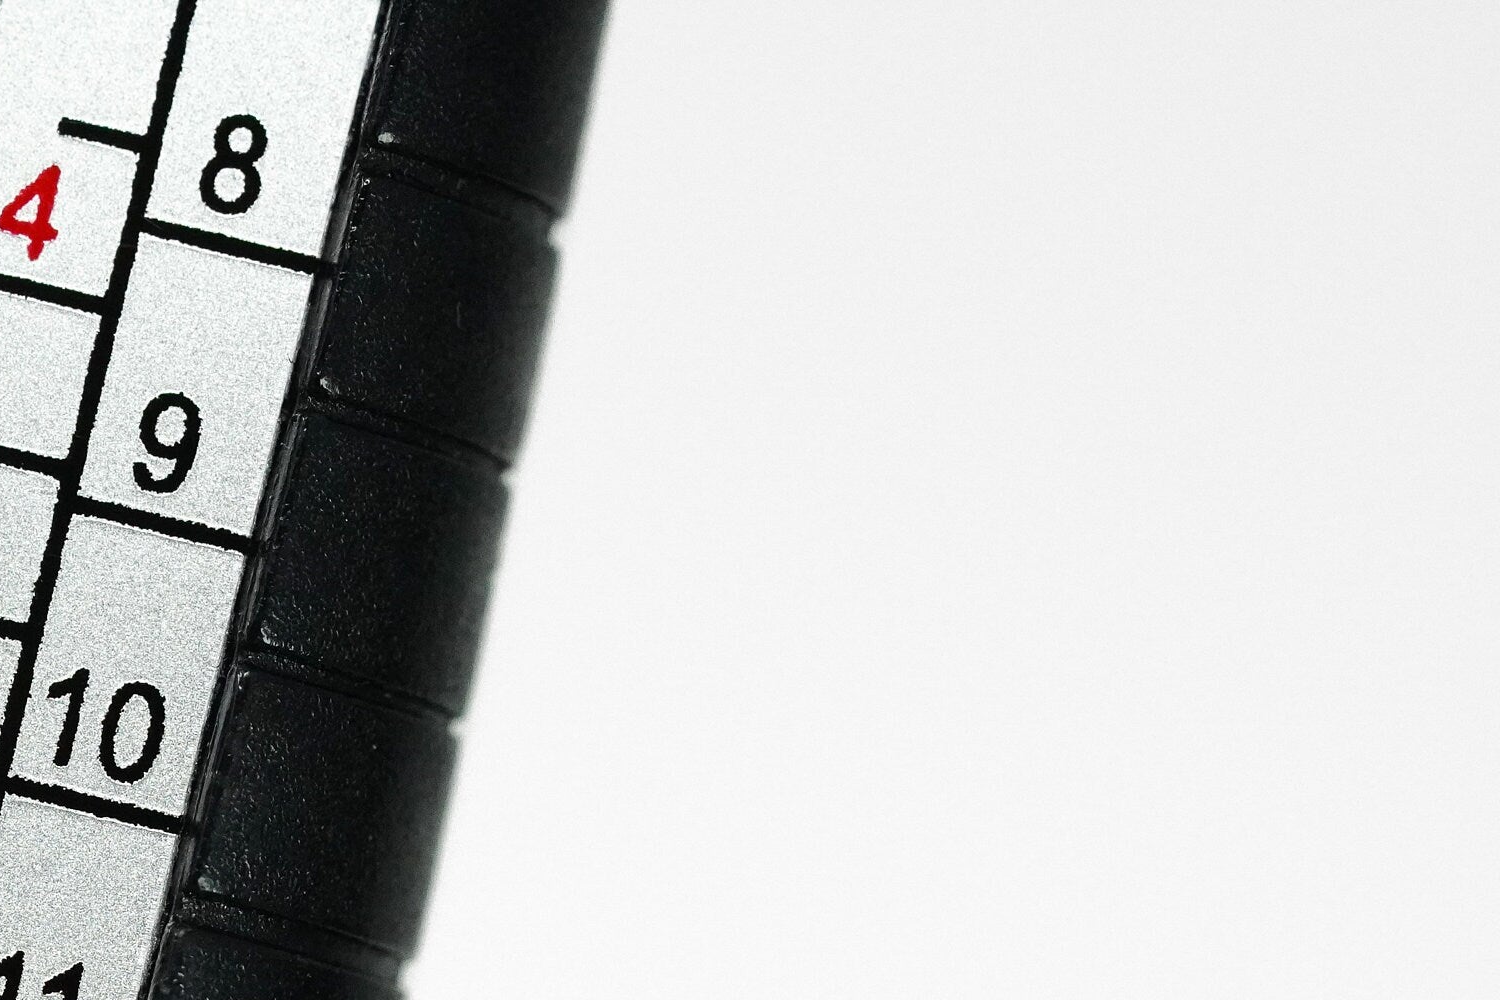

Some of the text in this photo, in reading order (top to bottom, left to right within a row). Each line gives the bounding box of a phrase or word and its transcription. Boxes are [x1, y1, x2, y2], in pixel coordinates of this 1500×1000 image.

[199, 114, 268, 215] 8
[133, 392, 203, 494] 9
[47, 668, 166, 785] 10
